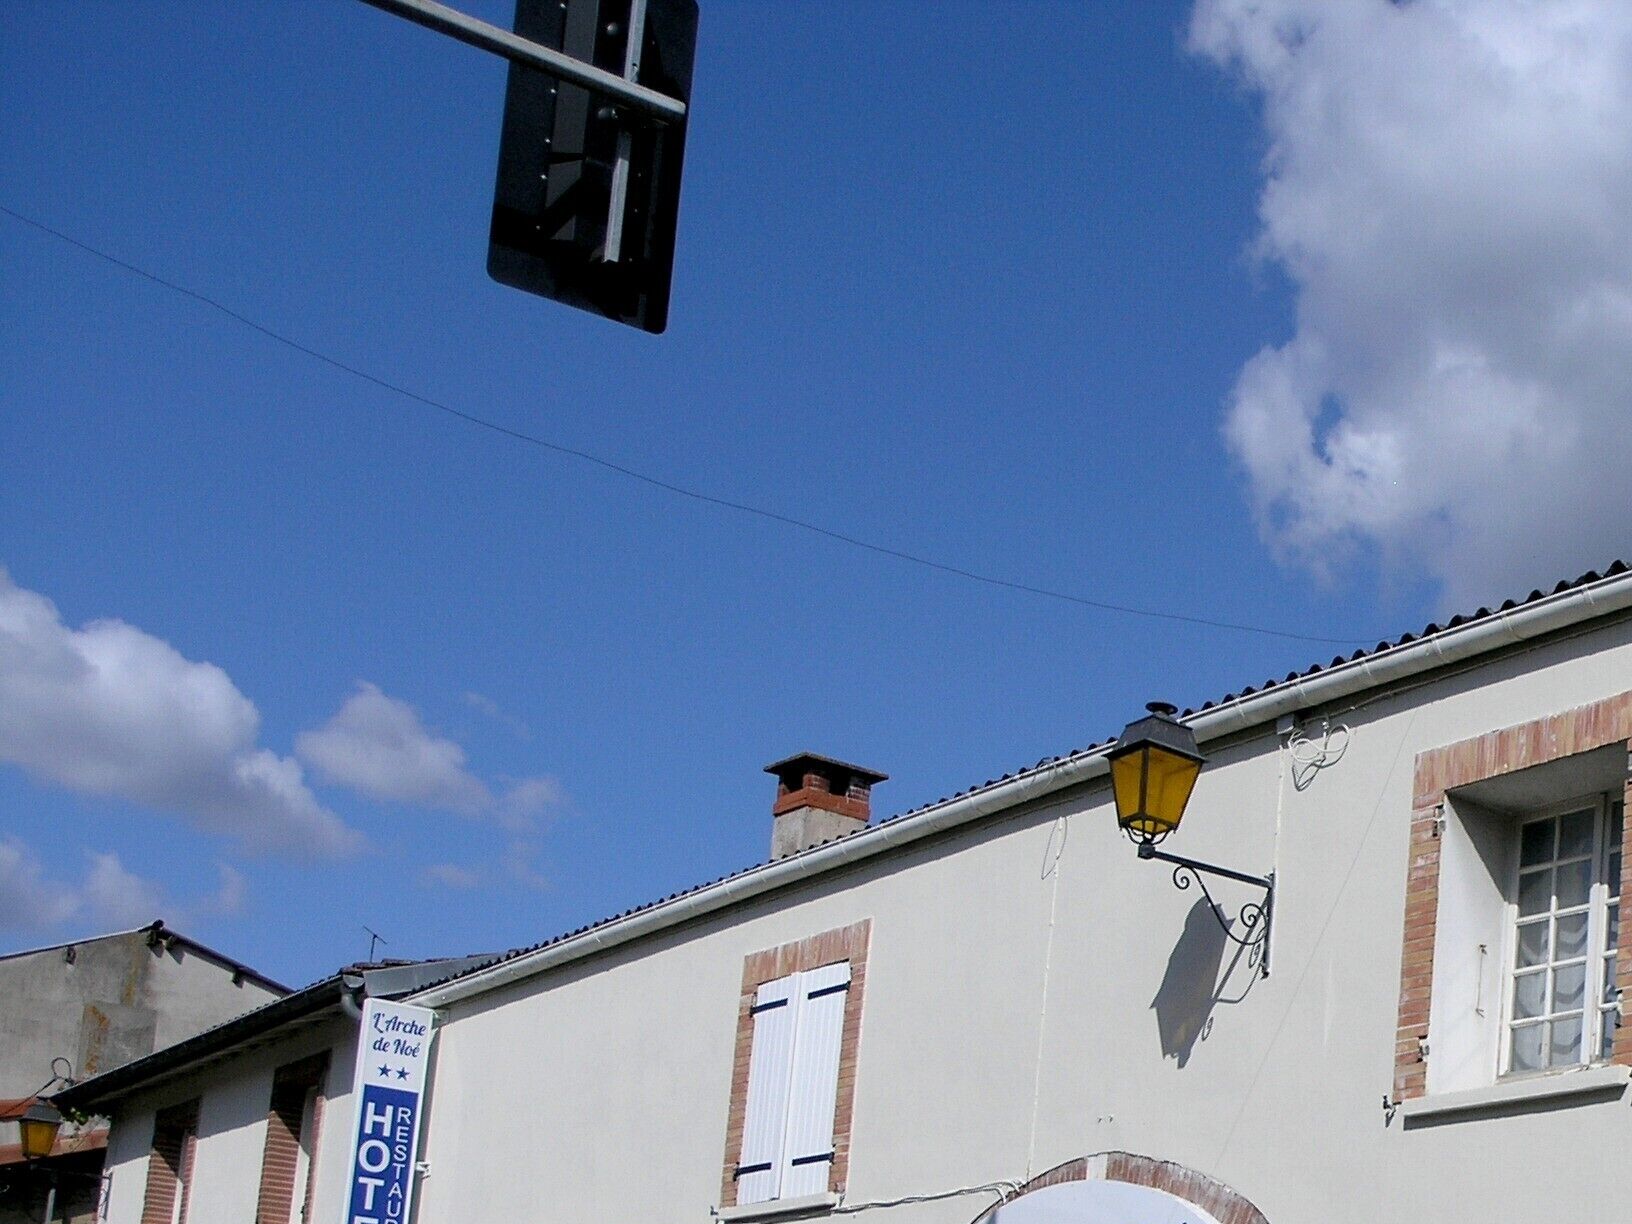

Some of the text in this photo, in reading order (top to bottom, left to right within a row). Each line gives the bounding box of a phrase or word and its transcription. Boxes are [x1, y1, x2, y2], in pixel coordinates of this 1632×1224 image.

[373, 1011, 427, 1037] L'Arche
[373, 1036, 421, 1058] de Noé
